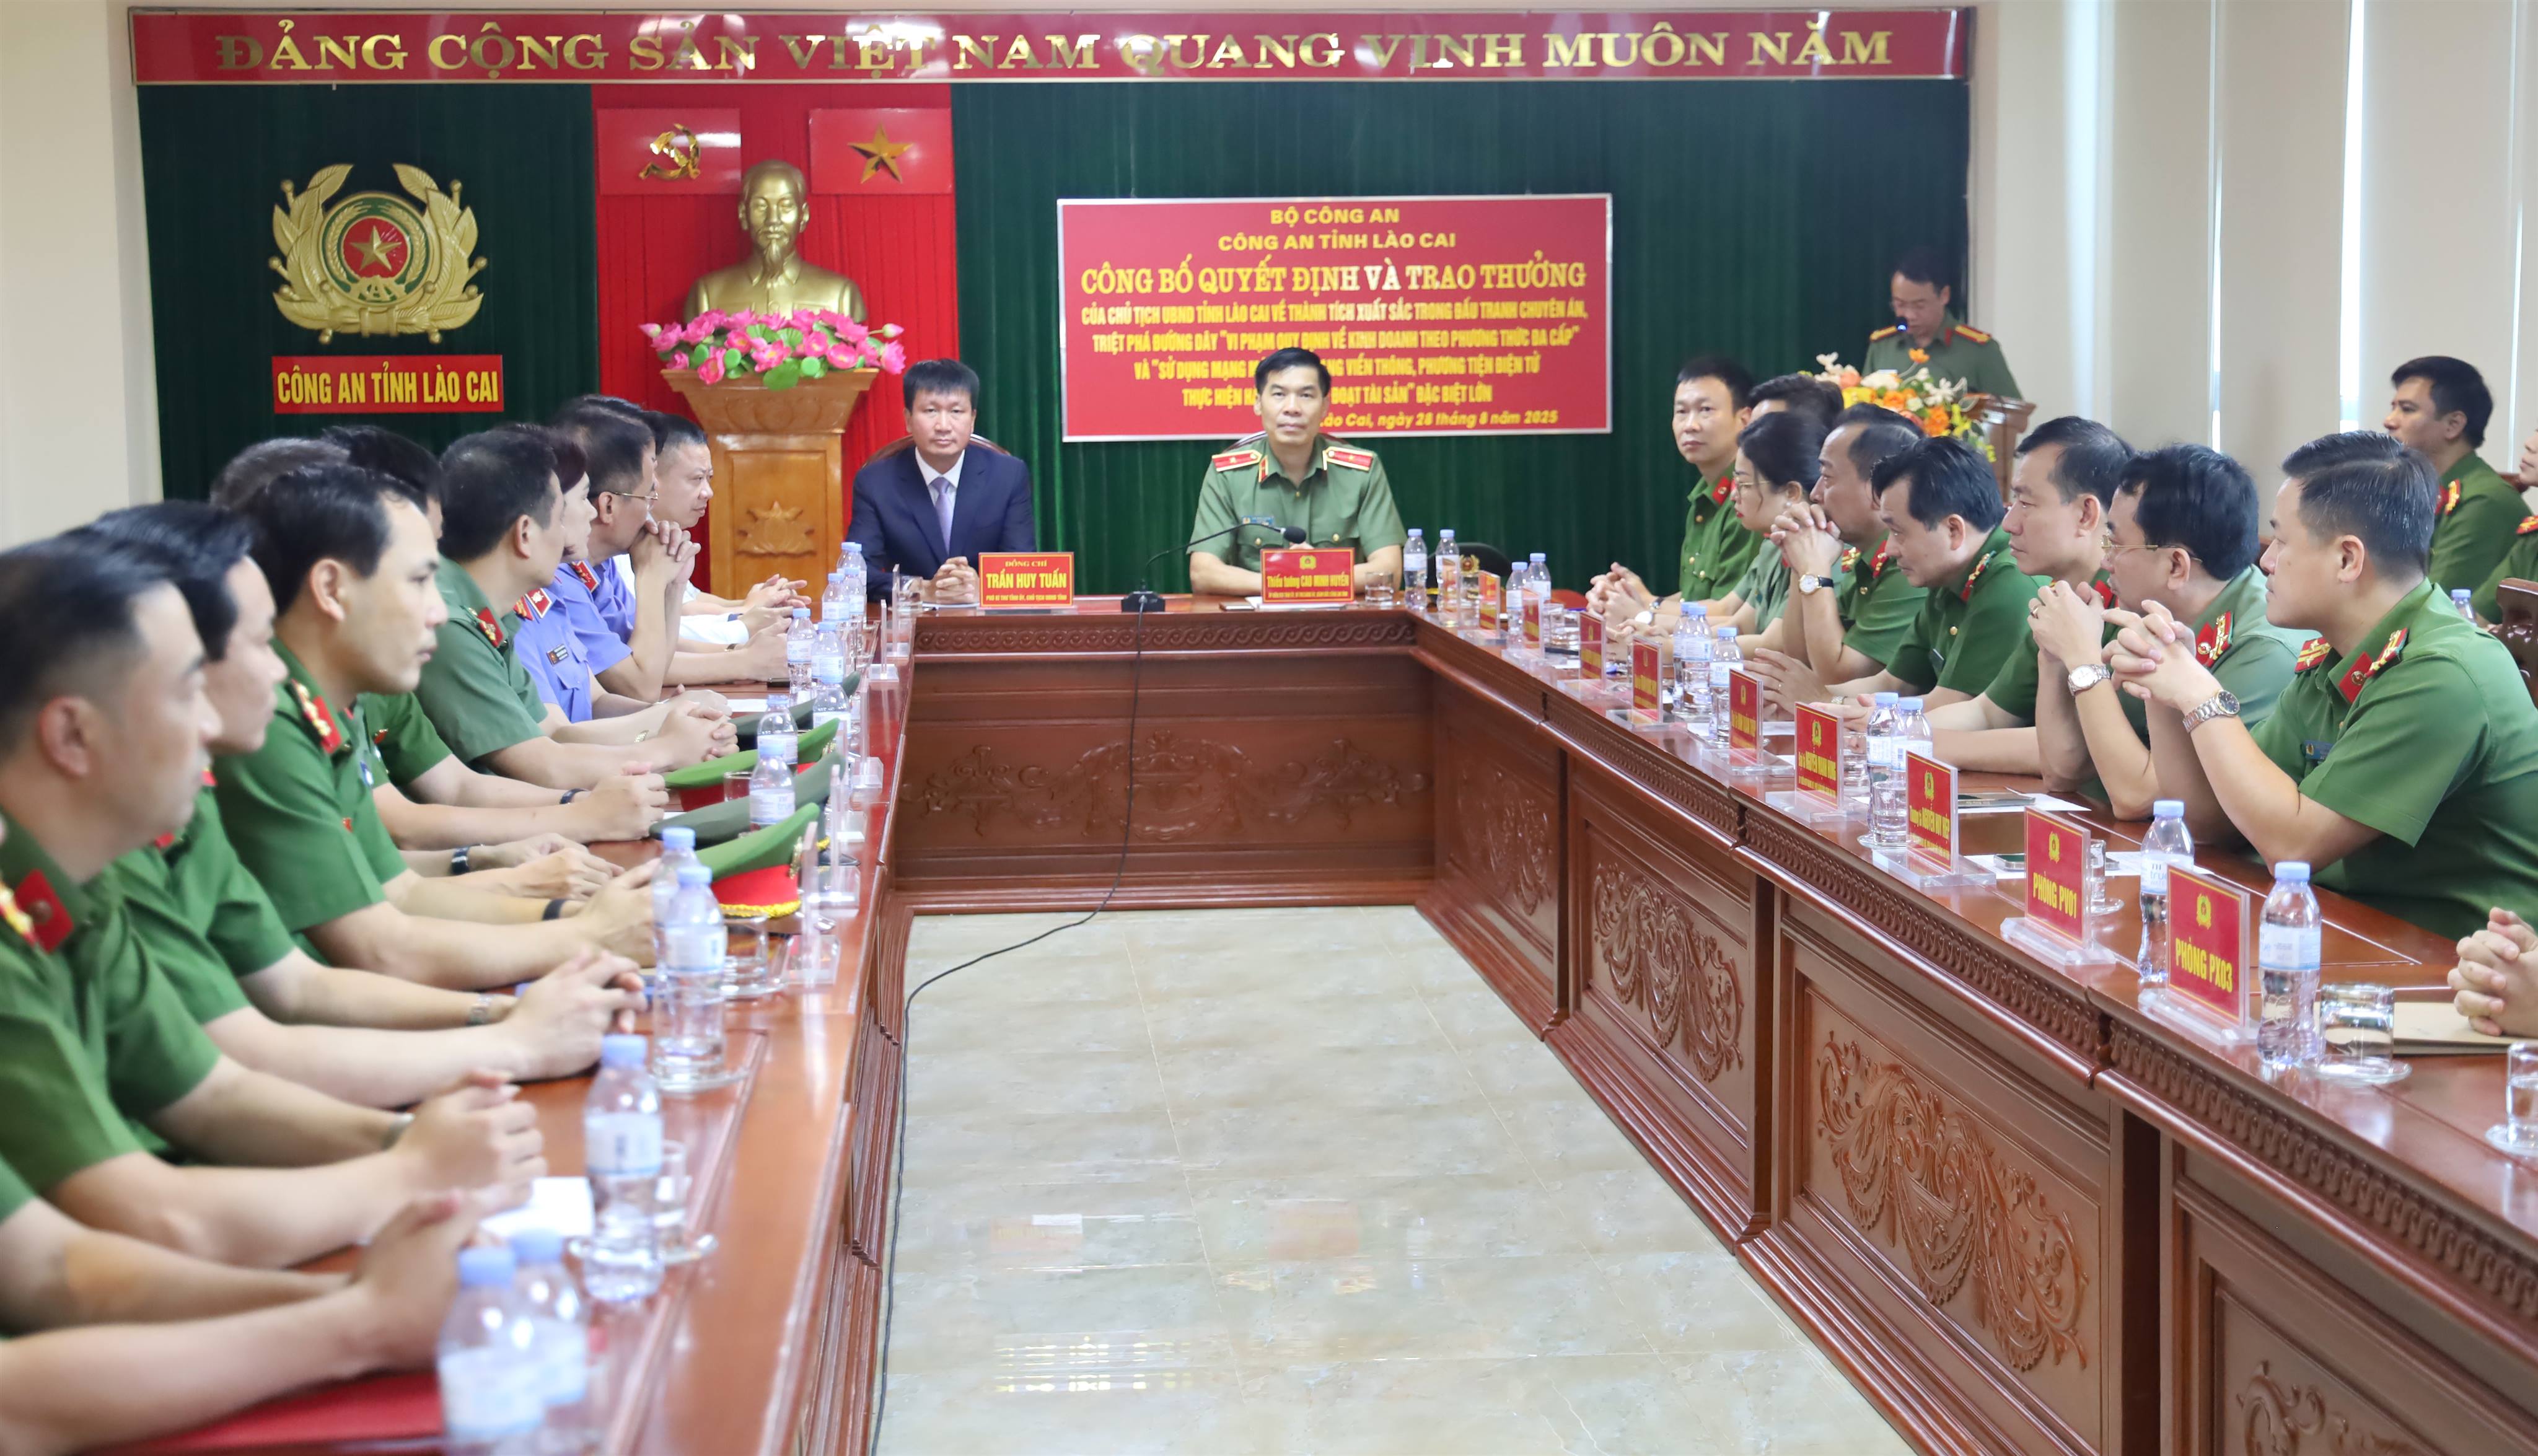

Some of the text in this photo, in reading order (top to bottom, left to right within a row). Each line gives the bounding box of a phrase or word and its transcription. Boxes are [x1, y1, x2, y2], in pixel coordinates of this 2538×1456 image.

[216, 19, 1893, 79] ĐẢNG CỘNG SẢN VIỆT NAM QUANG VINH MUÔN NĂM
[1270, 206, 1400, 227] BỘ CÔNG AN
[1218, 229, 1456, 251] CÔNG AN TỈNH LÀO CAI
[1081, 250, 1587, 297] CÔNG BỐ QUYẾT ĐỊNH VÀ TRAO THƯỞNG
[1082, 301, 1106, 325] CỦA
[1108, 300, 1131, 324] CHỦ
[1134, 307, 1160, 327] TỊCH
[1162, 307, 1194, 323] UBND
[1197, 300, 1224, 323] TỈNH
[1226, 302, 1248, 323] LÀO
[1250, 305, 1270, 322] CAI
[1271, 298, 1286, 322] VỀ
[1288, 300, 1327, 322] THÀNH
[1328, 300, 1355, 321] TÍCH
[1356, 297, 1386, 321] XUẤT
[1389, 296, 1413, 320] SẮC
[1415, 302, 1452, 319] TRONG
[1454, 296, 1478, 319] ĐẤU
[1480, 301, 1517, 318] TRANH
[1519, 298, 1565, 318] CHUYÊN
[1092, 331, 1125, 354] TRIỆT
[1126, 330, 1151, 352] PHÁ
[1153, 330, 1193, 351] ĐƯỜNG
[1195, 330, 1218, 351] DÂY
[1240, 331, 1275, 353] PHẠM
[1277, 332, 1300, 350] QUY
[1301, 331, 1330, 352] ĐỊNH
[1331, 325, 1346, 349] VỀ
[1348, 331, 1377, 348] KINH
[1379, 330, 1418, 348] DOANH
[1420, 330, 1449, 347] THEO
[1451, 328, 1498, 347] PHƯƠNG
[1500, 326, 1530, 346] THỨC
[1134, 358, 1150, 379] VÀ
[1177, 361, 1209, 382] DỤNG
[1211, 361, 1246, 380] MẠNG
[1346, 353, 1373, 376] VIỄN
[1418, 356, 1466, 375] PHƯƠNG
[1468, 354, 1494, 377] TIỆN
[1496, 353, 1524, 376] ĐIỆN
[1525, 350, 1541, 373] TỬ
[277, 361, 498, 404] CÔNG AN TỈNH LÀO CAI
[1330, 386, 1361, 408] ĐOẠT
[1364, 383, 1382, 404] TÀI
[1416, 384, 1441, 406] ĐẶC
[1442, 382, 1466, 405] BIỆT
[1469, 380, 1493, 403] LỚN
[1182, 387, 1213, 410] THỰC
[1214, 385, 1242, 409] HIỆN
[1320, 412, 1343, 427] ào
[1345, 413, 1374, 428] Cai,
[1378, 411, 1414, 429] ngày
[1435, 411, 1477, 428] tháng
[1490, 411, 1520, 424] năm
[1524, 410, 1558, 424] 2025
[1016, 572, 1037, 588] HUY
[1039, 568, 1067, 588] TUẤN
[2033, 871, 2076, 919] PHÒNG PV01
[2176, 937, 2233, 993] PHÒNG PX03
